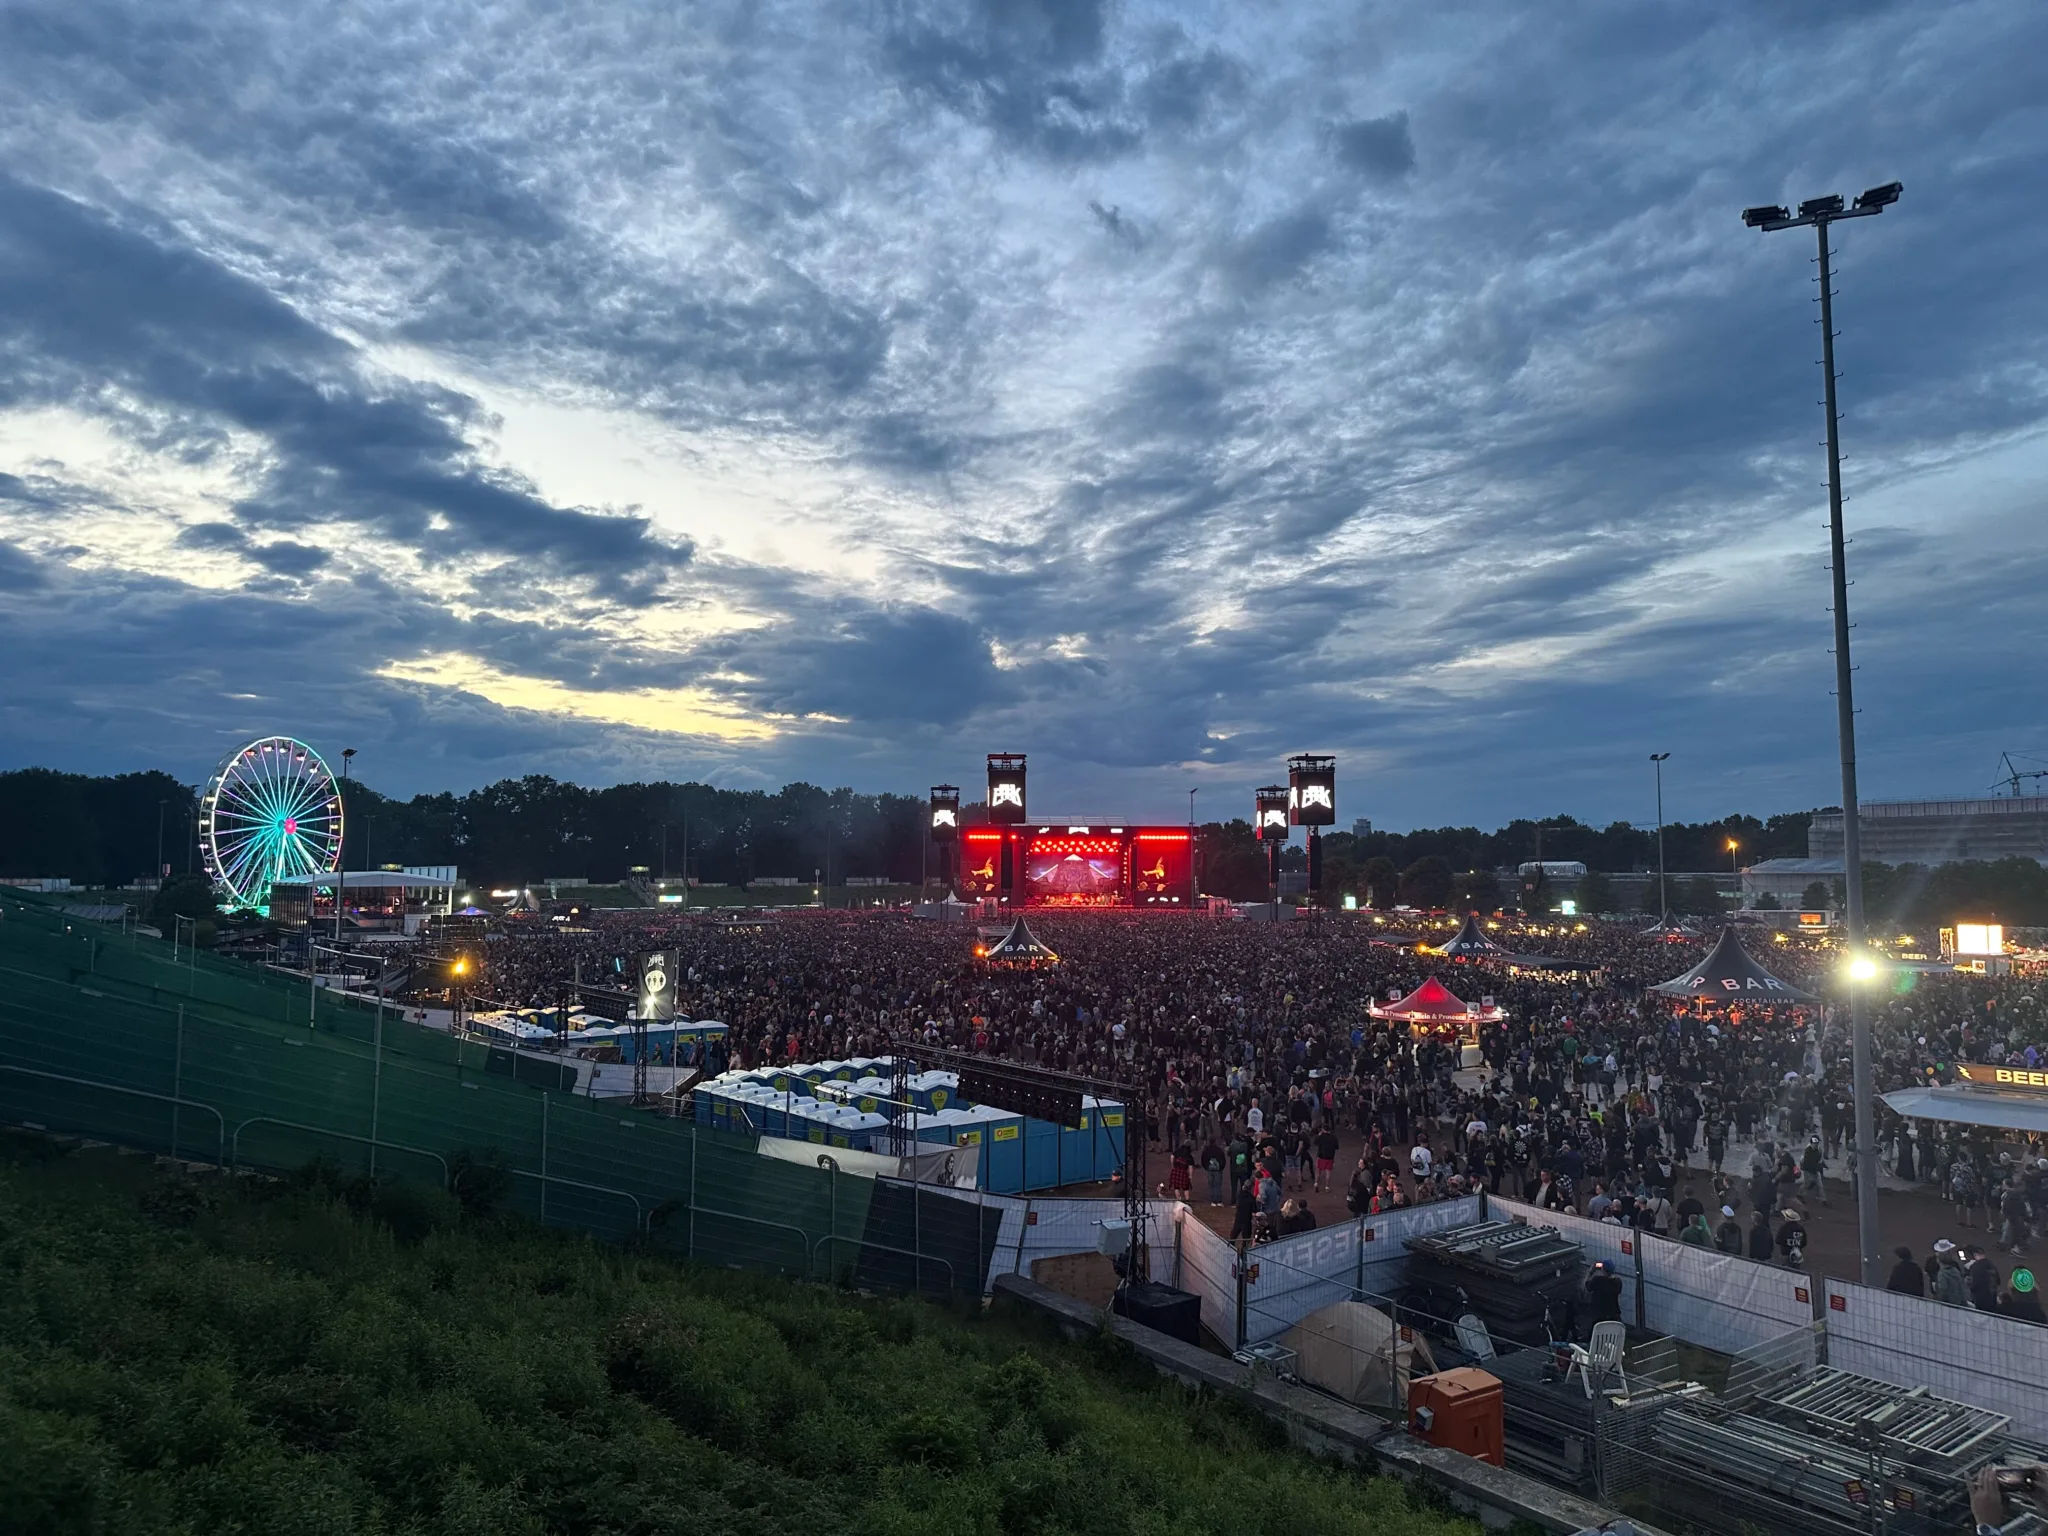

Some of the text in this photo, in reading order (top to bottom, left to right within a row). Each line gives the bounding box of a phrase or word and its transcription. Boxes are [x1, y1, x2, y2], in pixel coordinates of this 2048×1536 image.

[1004, 943, 1039, 952] BAR
[1460, 941, 1495, 950] BAR
[1720, 978, 1784, 991] BAR
